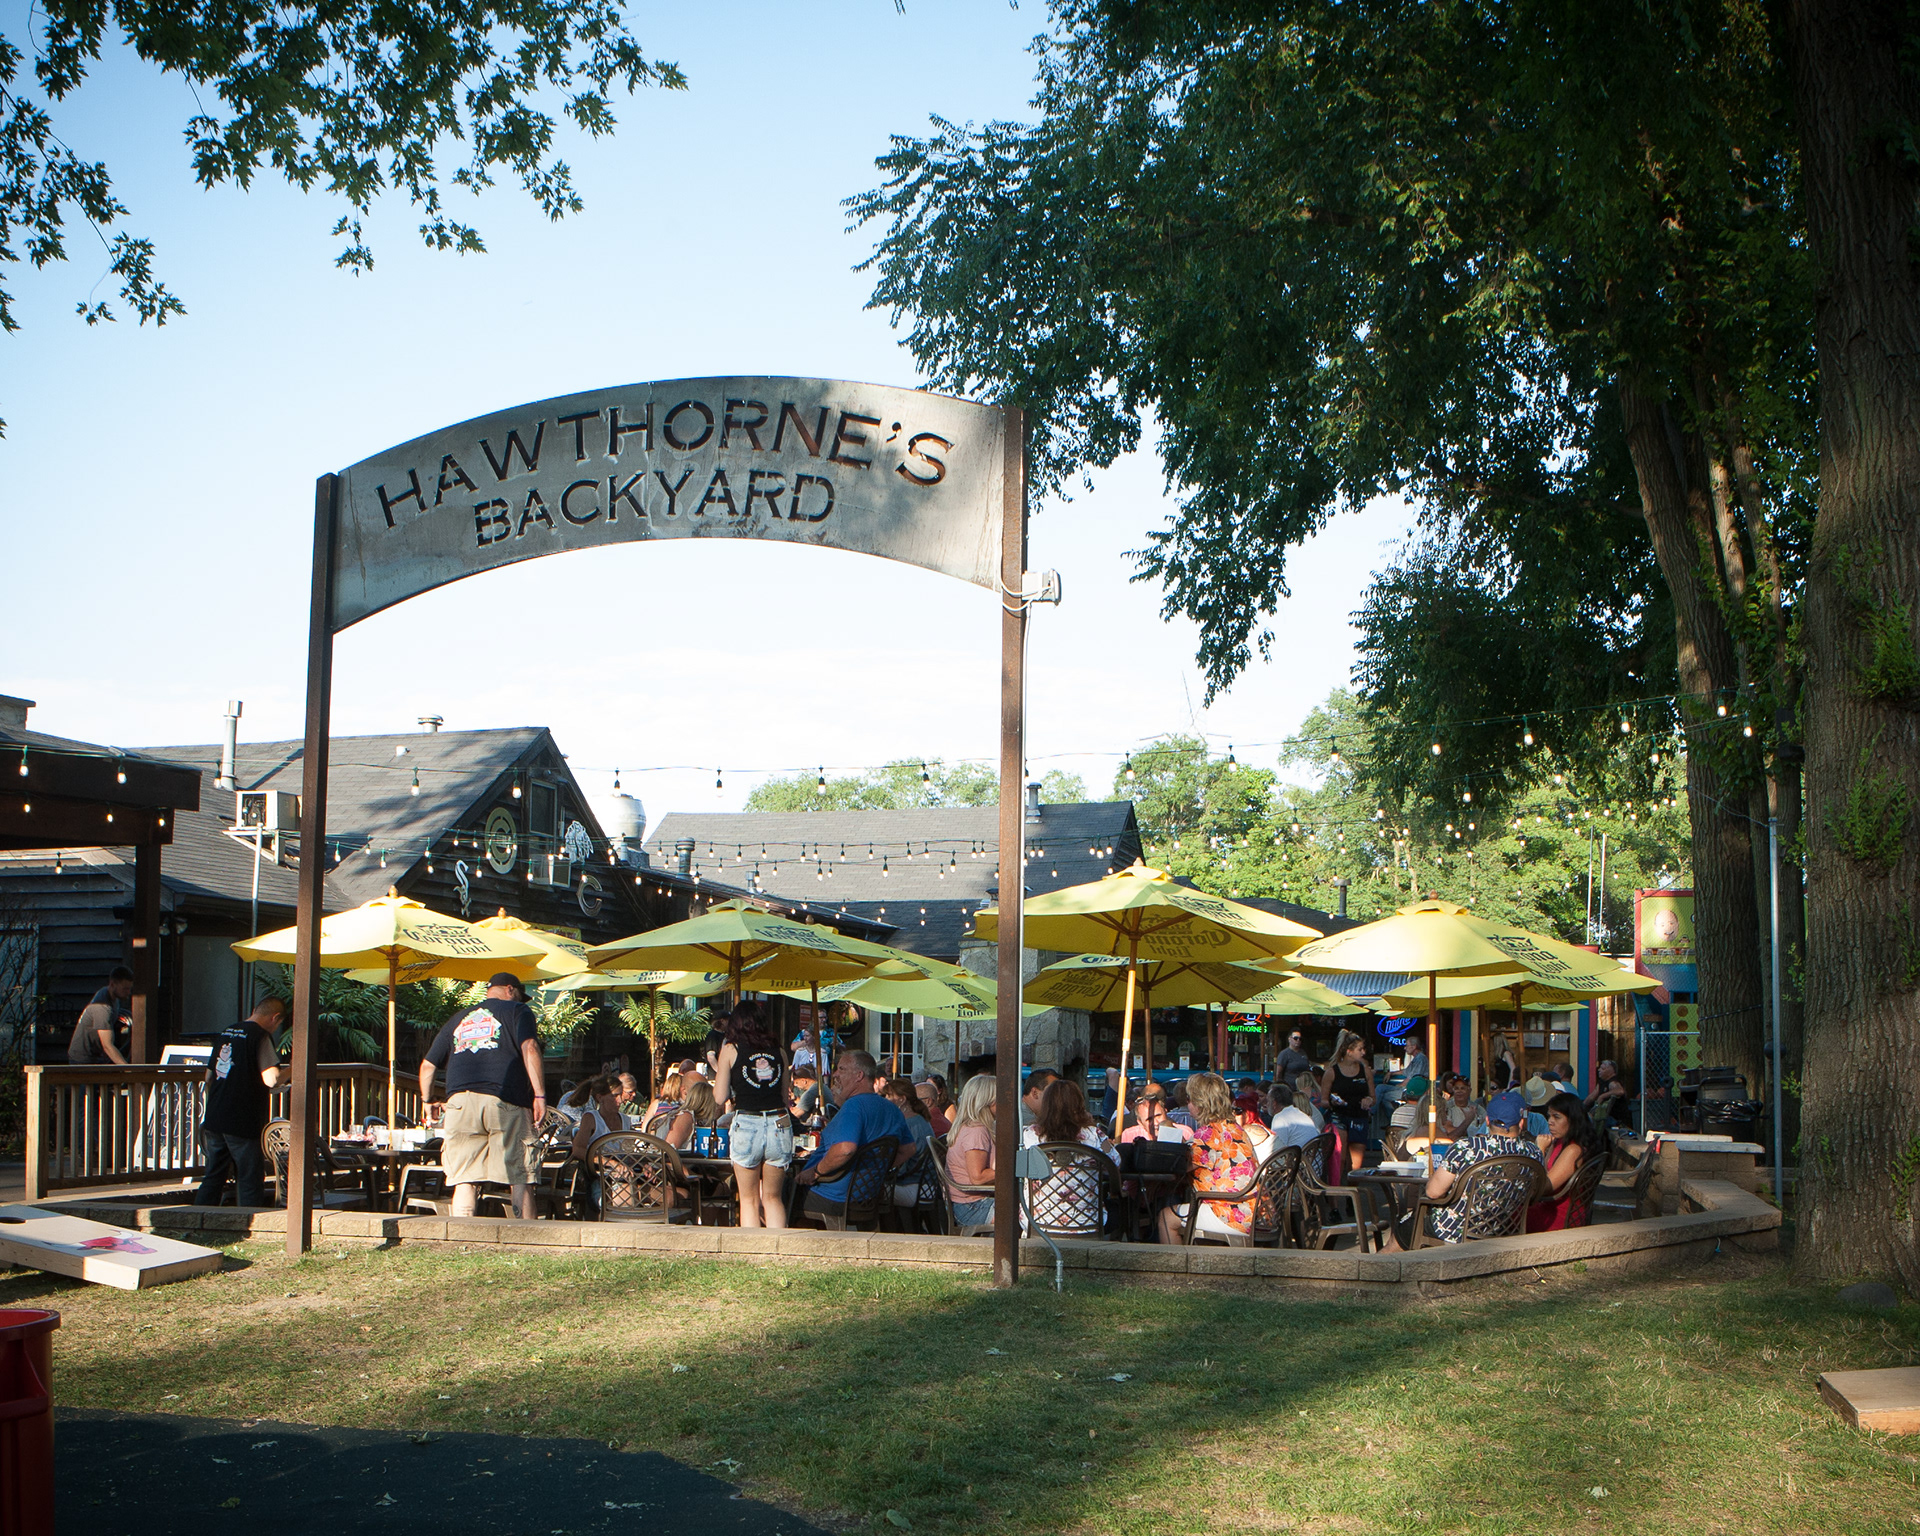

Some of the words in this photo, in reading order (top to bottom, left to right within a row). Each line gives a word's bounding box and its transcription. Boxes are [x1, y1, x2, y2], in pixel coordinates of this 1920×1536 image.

[375, 398, 955, 529] HAWTHORNE'S
[473, 469, 835, 548] BACKYARD
[403, 928, 484, 946] Corona
[451, 943, 493, 955] Light
